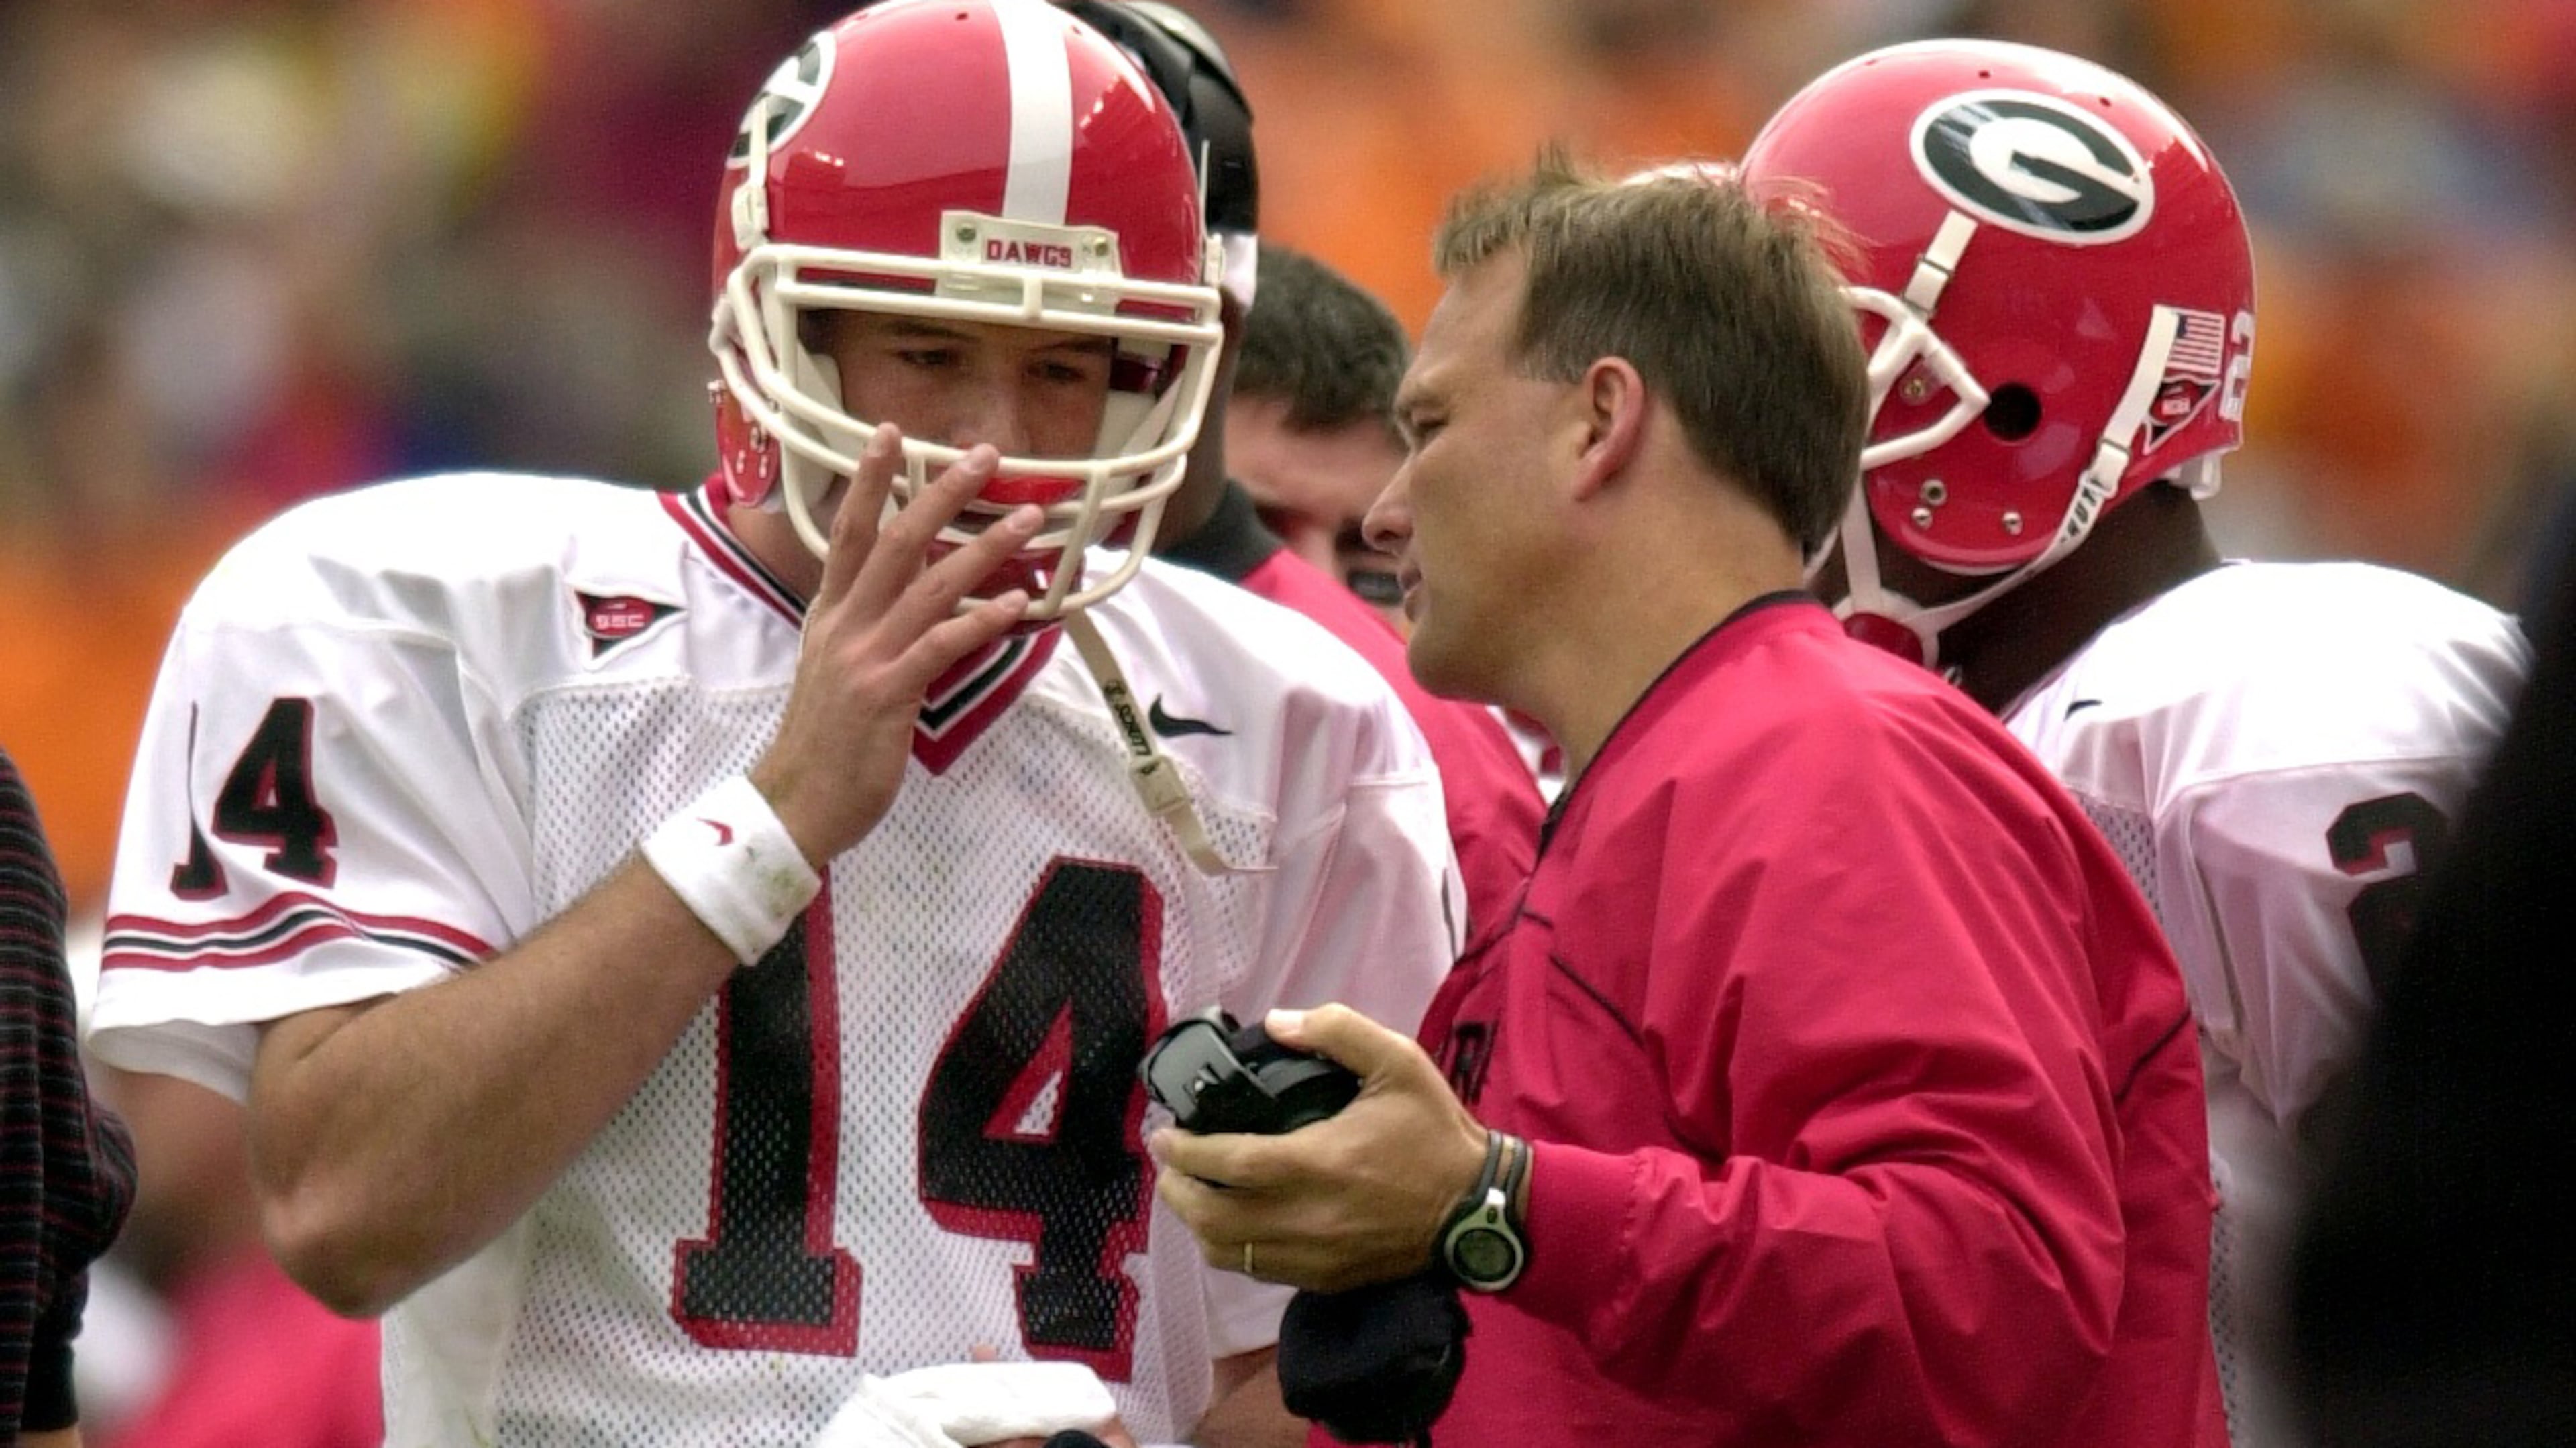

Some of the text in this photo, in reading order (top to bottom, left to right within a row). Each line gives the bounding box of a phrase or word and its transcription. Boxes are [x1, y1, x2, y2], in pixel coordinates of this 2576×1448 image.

[987, 239, 1072, 268] DAWGS
[170, 696, 339, 902] 14
[667, 854, 1168, 1383] 14
